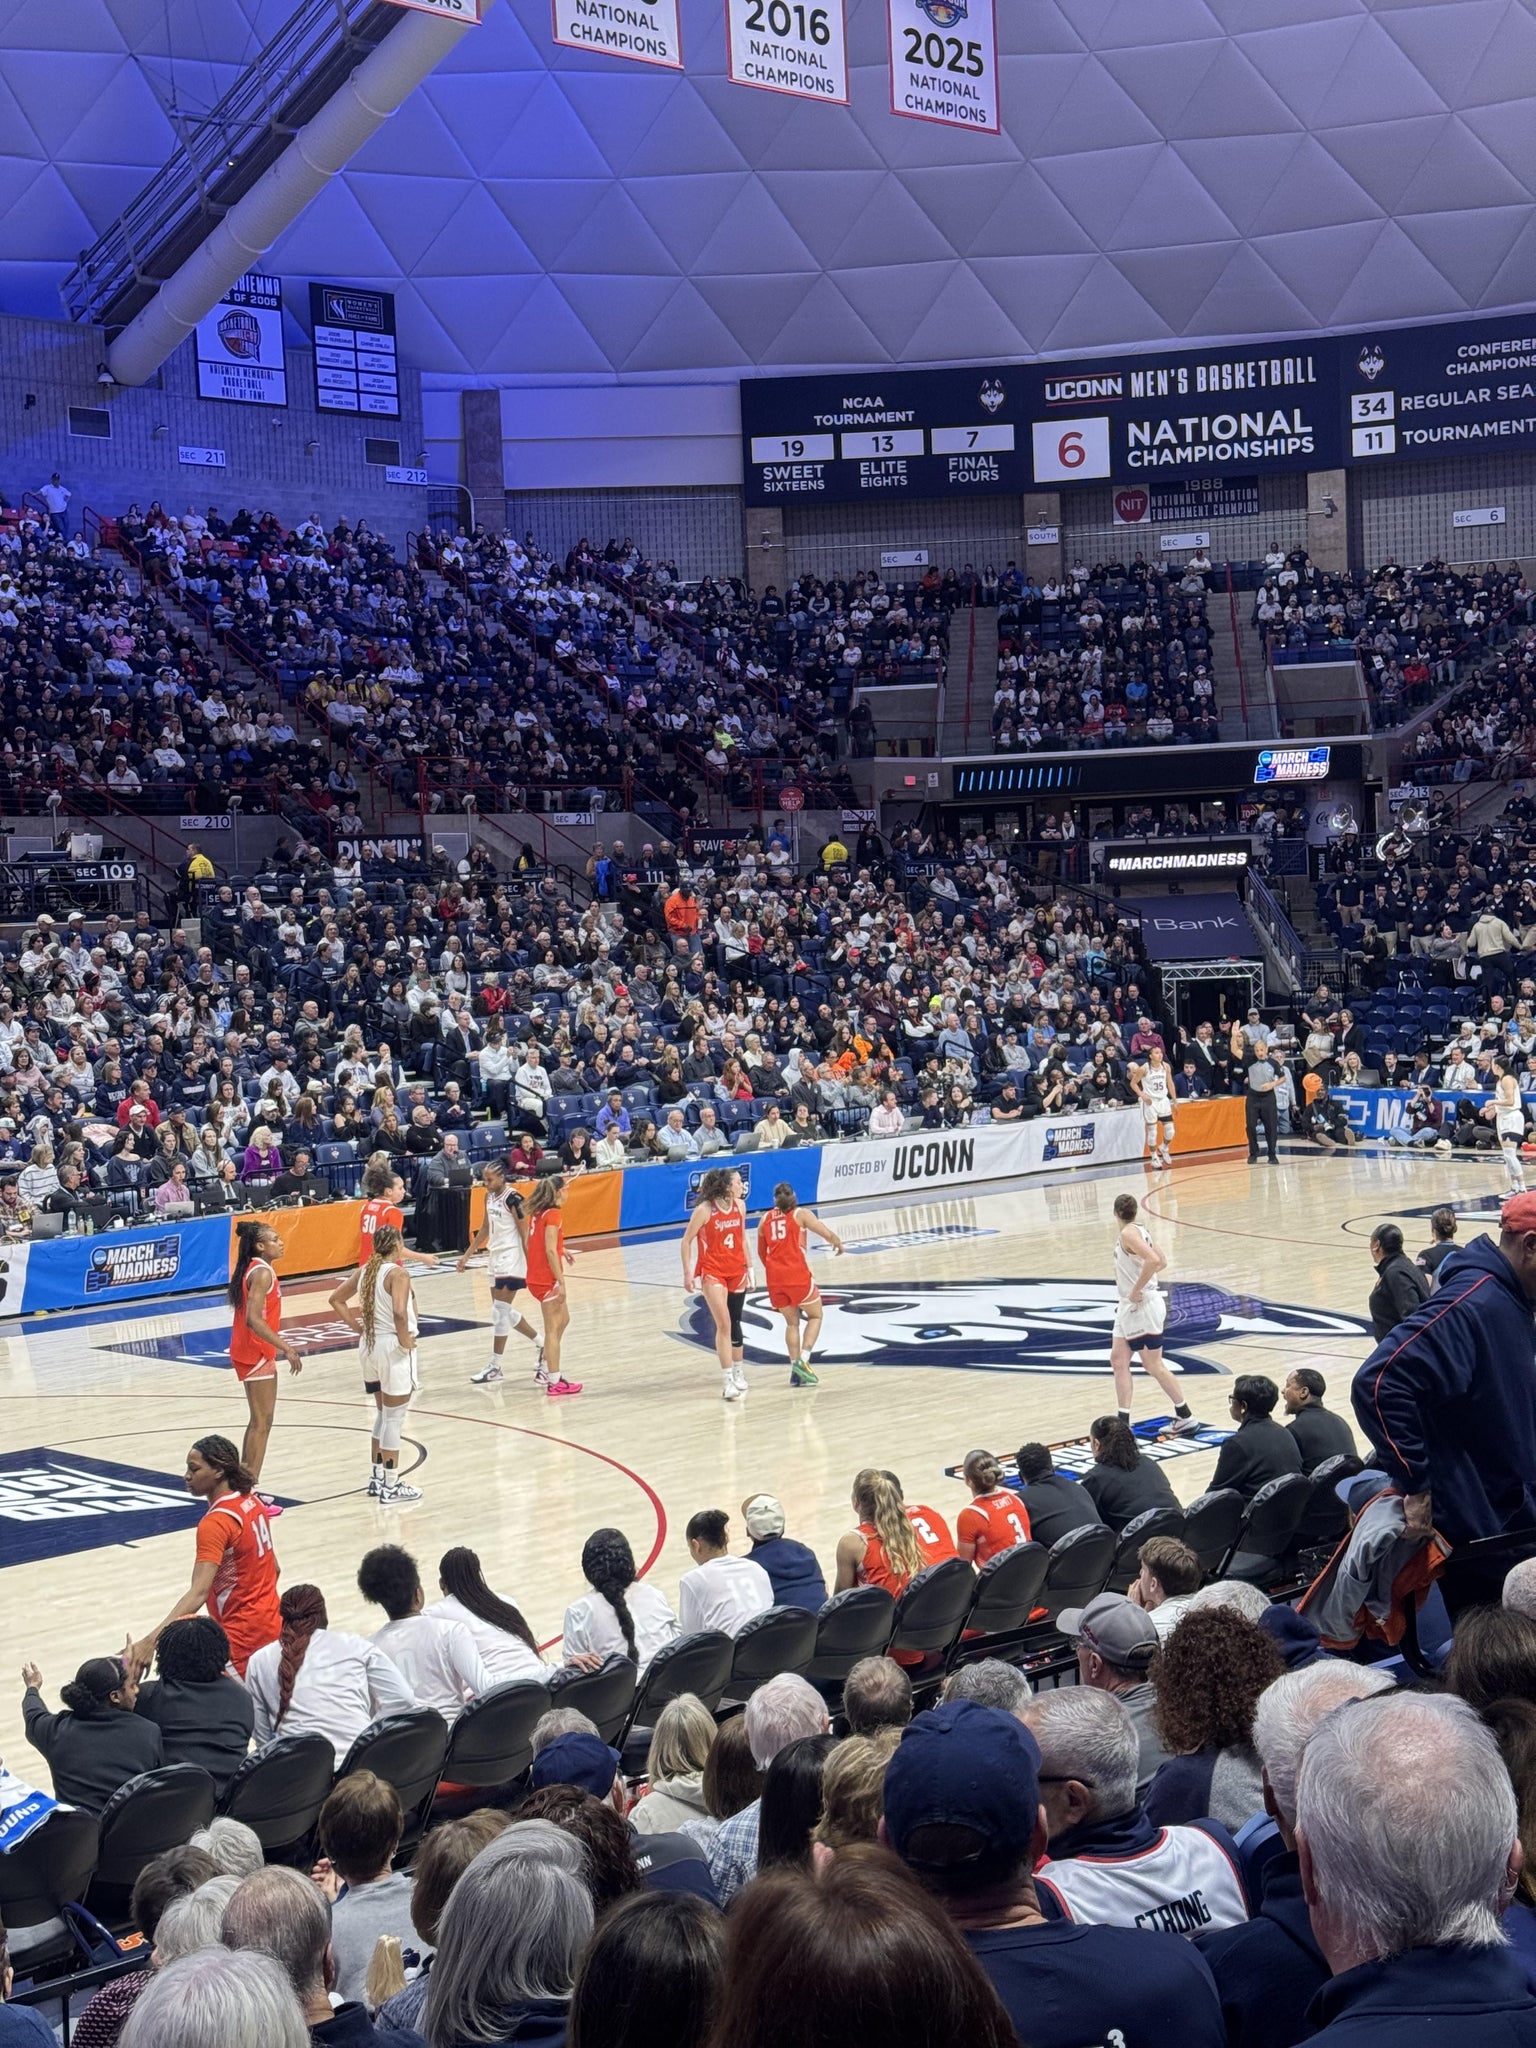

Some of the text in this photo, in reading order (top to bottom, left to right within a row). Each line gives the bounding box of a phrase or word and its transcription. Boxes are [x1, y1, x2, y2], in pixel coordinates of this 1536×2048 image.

[575, 0, 659, 31] NATIONAL
[745, 0, 830, 46] 2016
[570, 23, 667, 57] CHAMPIONS
[750, 40, 827, 70] NATIONAL
[902, 27, 984, 77] 2025
[744, 63, 834, 94] CHAMPIONS
[909, 73, 980, 100] NATIONAL
[905, 94, 986, 123] CHAMPIONS
[250, 295, 277, 306] 2006
[1045, 356, 1317, 401] UCONN MEN'S BASKETBALL
[842, 396, 884, 409] NCAA
[1357, 399, 1388, 418] 34
[1400, 387, 1491, 412] REGULAR
[814, 410, 915, 426] TOURNAMENT
[1127, 408, 1313, 448] NATIONAL
[1365, 417, 1536, 450] 11 TOURNAMENT
[871, 435, 894, 453] 13
[966, 431, 979, 448] 7
[781, 440, 804, 457] 19
[1058, 431, 1086, 469] 6
[1126, 436, 1315, 469] CHAMPIONSHIPS
[180, 452, 225, 464] SEC 211
[948, 455, 999, 471] FINAL
[762, 464, 825, 481] SWEET
[859, 460, 907, 475] ELITE
[387, 471, 426, 482] SEC 212
[860, 474, 908, 488] EIGHTS
[948, 469, 999, 484] FOURS
[1184, 478, 1223, 492] 1988
[763, 479, 825, 493] SIXTEENS
[1121, 498, 1143, 511] NIT
[1151, 488, 1258, 508] NATIONAL INVITATION
[1151, 501, 1259, 520] TOURNAMENT CHAMPION
[1455, 510, 1499, 524] SEC 6
[1029, 531, 1057, 541] SOUTH
[1162, 535, 1203, 547] SEC 5
[882, 552, 923, 565] SEC 4
[1272, 752, 1309, 764] MARCH
[1276, 762, 1328, 775] MADNESS
[1409, 787, 1428, 797] 213
[182, 816, 230, 828] SEC 210
[555, 813, 593, 824] SEC 211
[860, 810, 875, 820] 212
[907, 866, 919, 874] SEC
[1109, 852, 1248, 871] #MARCHMADNESS
[1318, 853, 1326, 879] TRASH
[76, 864, 135, 879] SEC 109
[208, 894, 221, 903] SE
[1153, 916, 1239, 931] Bank
[1153, 1082, 1164, 1091] 35
[1054, 1127, 1082, 1142] MARCH
[1058, 1138, 1093, 1155] MADNESS
[834, 1138, 975, 1181] HOSTED BY UCONN
[362, 1214, 377, 1234] 30
[770, 1220, 786, 1240] 15
[723, 1233, 734, 1249] 4
[107, 1243, 154, 1265] MARCH
[113, 1256, 178, 1280] MADNESS
[250, 1513, 272, 1558] 14
[911, 1517, 940, 1545] 2
[1007, 1513, 1027, 1544] 3
[726, 1575, 759, 1612] 13
[1134, 1889, 1213, 1934] STRONG
[1107, 2029, 1126, 2048] 3
